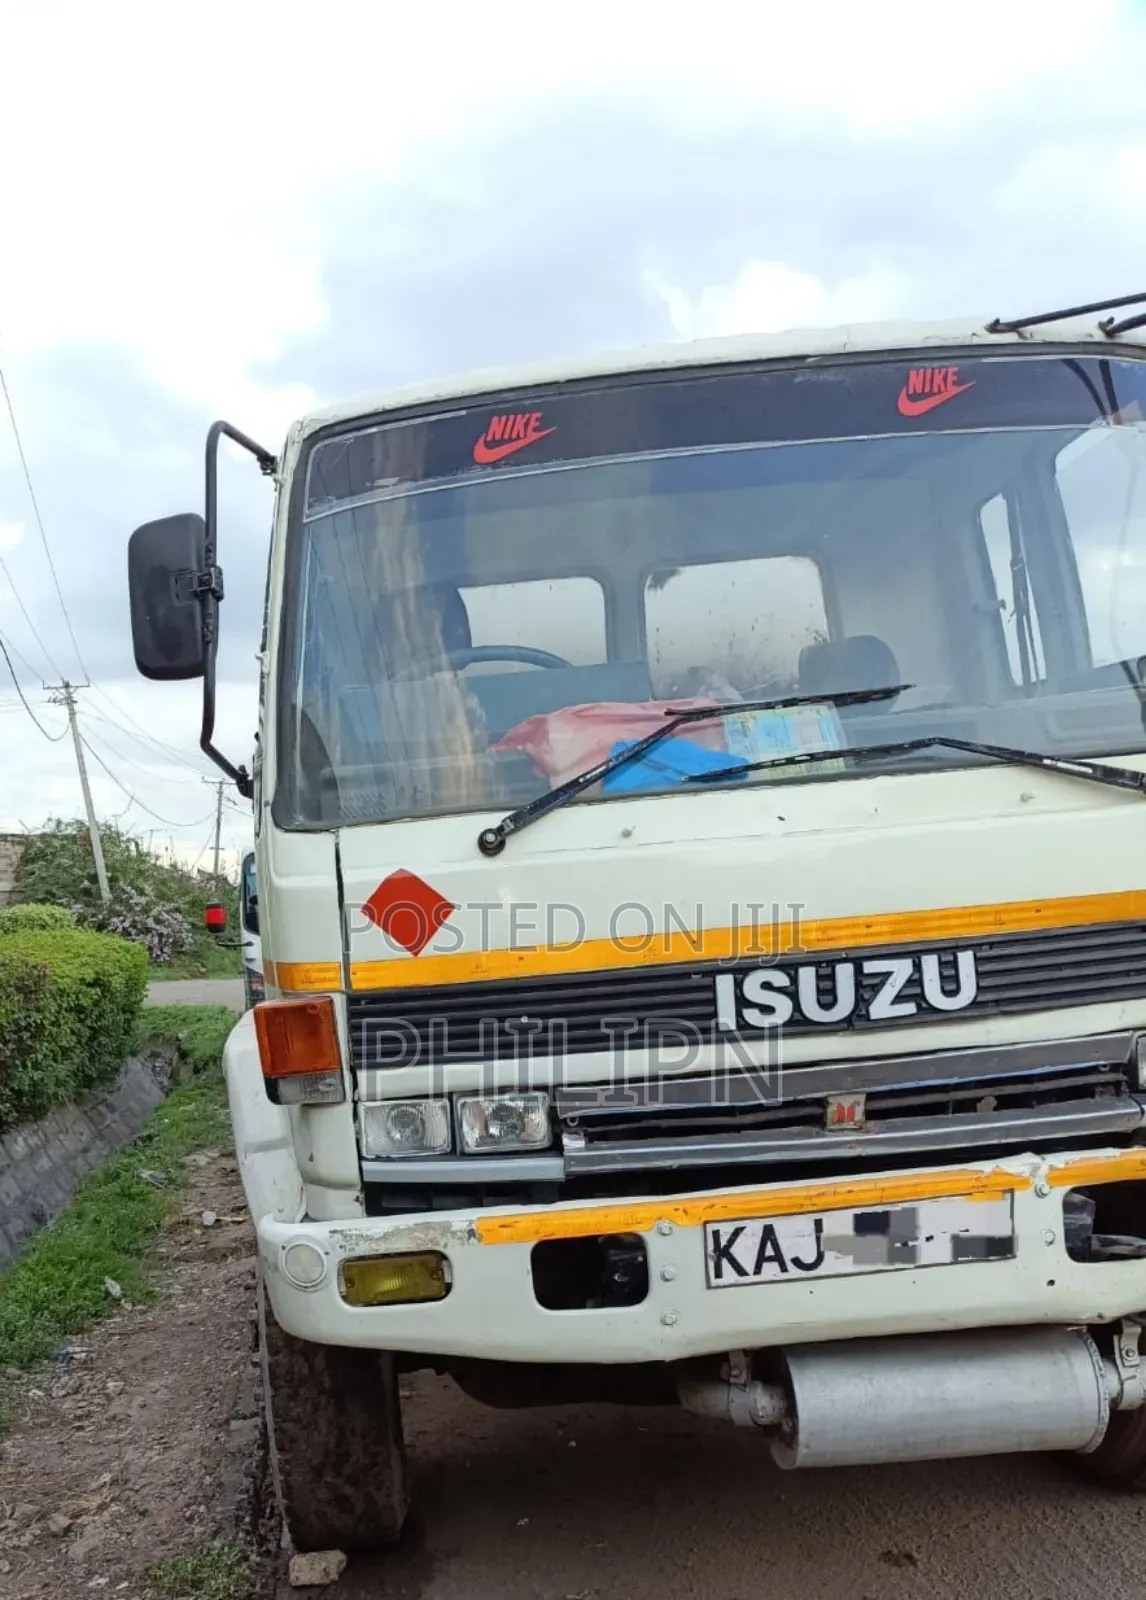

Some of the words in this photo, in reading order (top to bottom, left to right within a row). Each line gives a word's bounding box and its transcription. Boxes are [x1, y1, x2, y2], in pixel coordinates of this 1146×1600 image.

[908, 364, 959, 395] NIKE
[485, 411, 543, 441] NIKE
[714, 950, 978, 1032] ISUZU
[710, 1218, 825, 1279] KAJ
